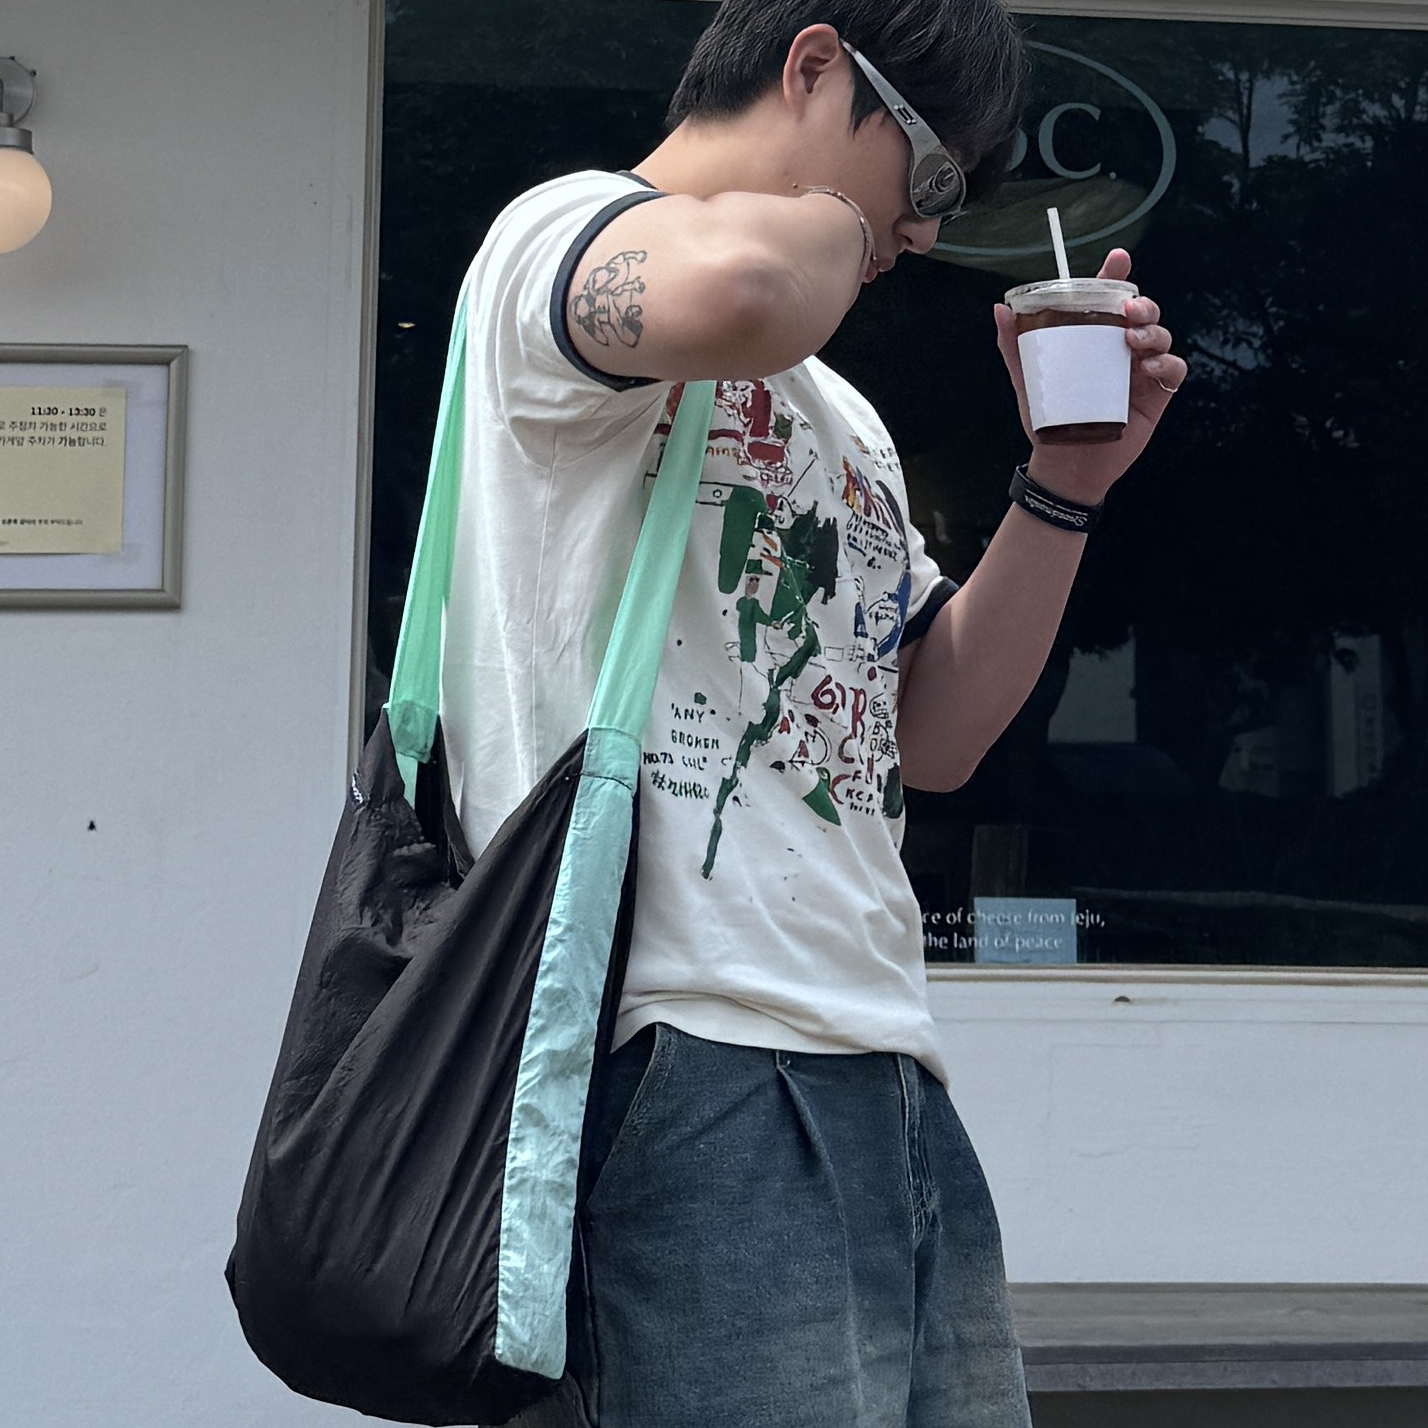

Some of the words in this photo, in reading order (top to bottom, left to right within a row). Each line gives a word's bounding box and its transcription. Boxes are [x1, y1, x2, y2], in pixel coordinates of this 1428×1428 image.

[672, 729, 720, 749] BROKEN
[946, 907, 963, 925] of
[967, 909, 1022, 926] cheese
[1028, 909, 1065, 923] from
[954, 932, 988, 949] land
[995, 933, 1011, 949] of
[1016, 936, 1063, 953] peace
